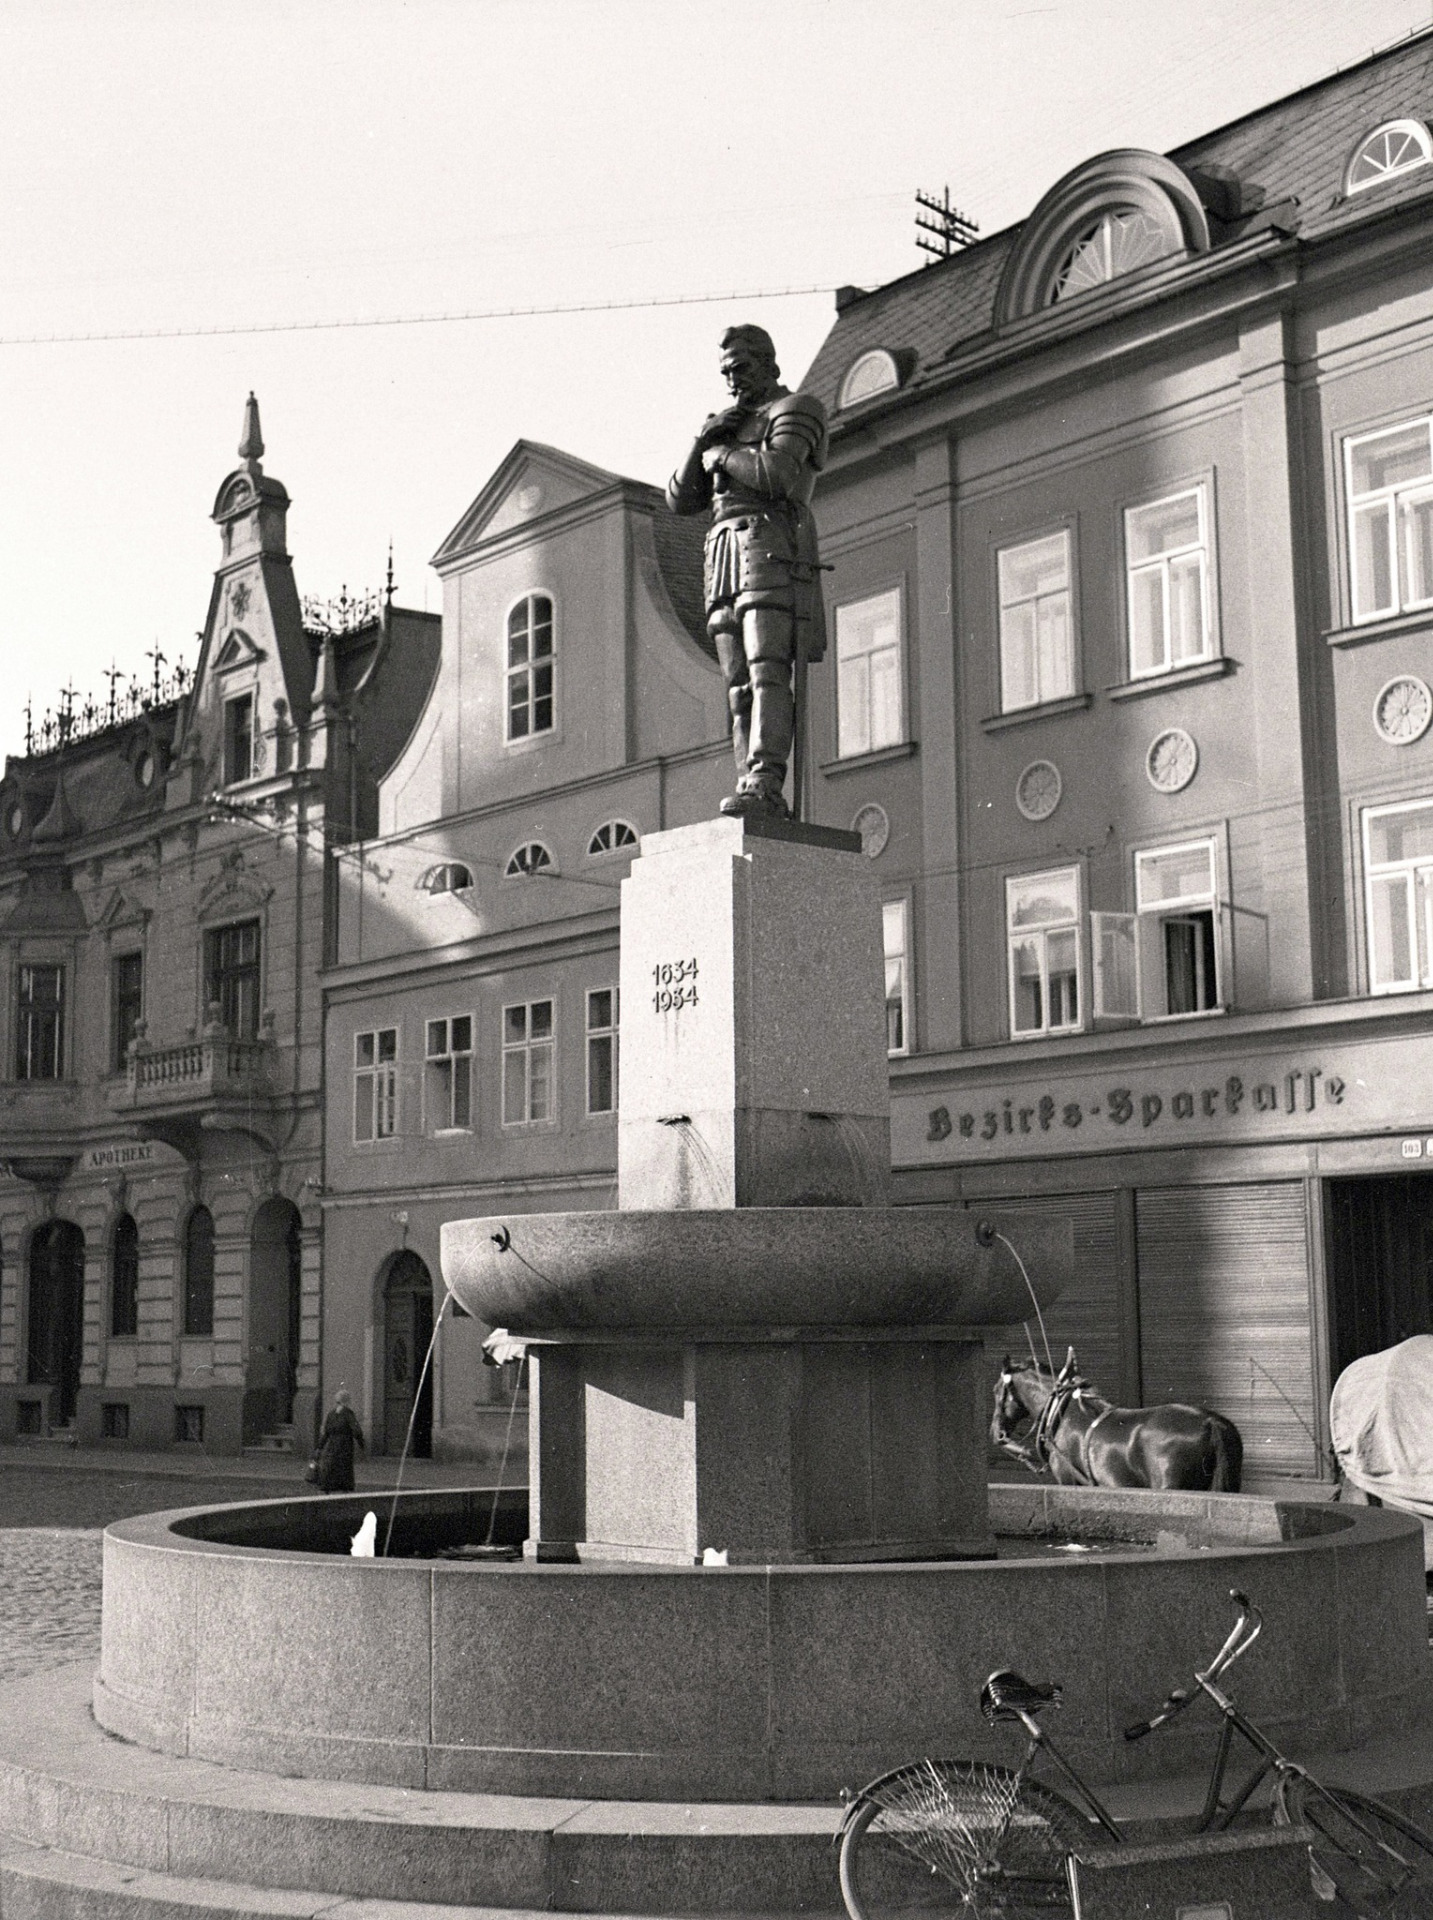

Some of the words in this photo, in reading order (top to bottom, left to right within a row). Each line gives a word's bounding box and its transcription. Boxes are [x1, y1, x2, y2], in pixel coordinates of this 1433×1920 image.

[651, 957, 699, 986] 1634
[651, 985, 699, 1013] 1934
[90, 1146, 152, 1166] APOTHEKE
